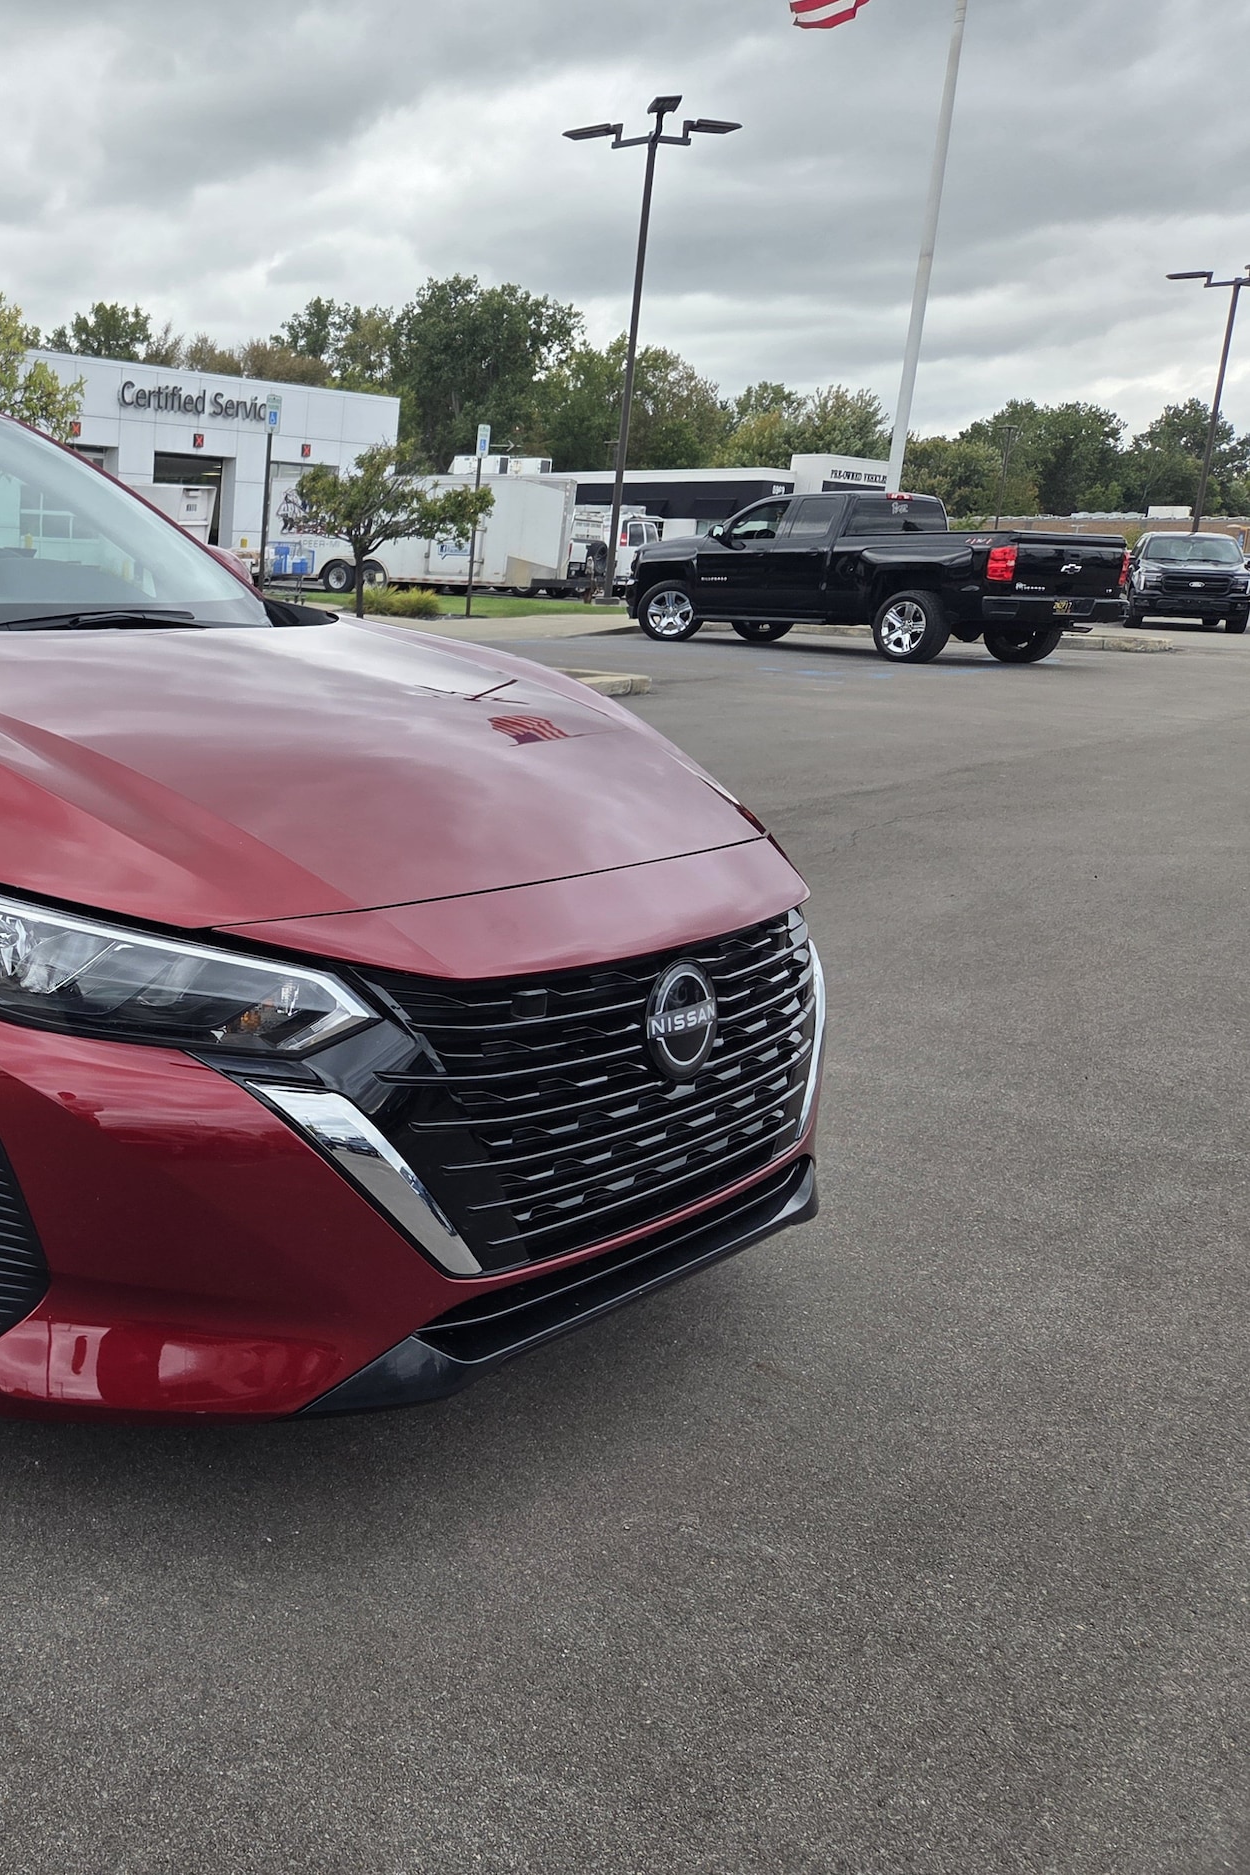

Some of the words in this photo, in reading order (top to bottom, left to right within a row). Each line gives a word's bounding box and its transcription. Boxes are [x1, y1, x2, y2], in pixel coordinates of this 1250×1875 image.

[120, 380, 206, 415] Certified
[211, 392, 266, 421] Servic
[651, 1002, 715, 1035] NISSAN
